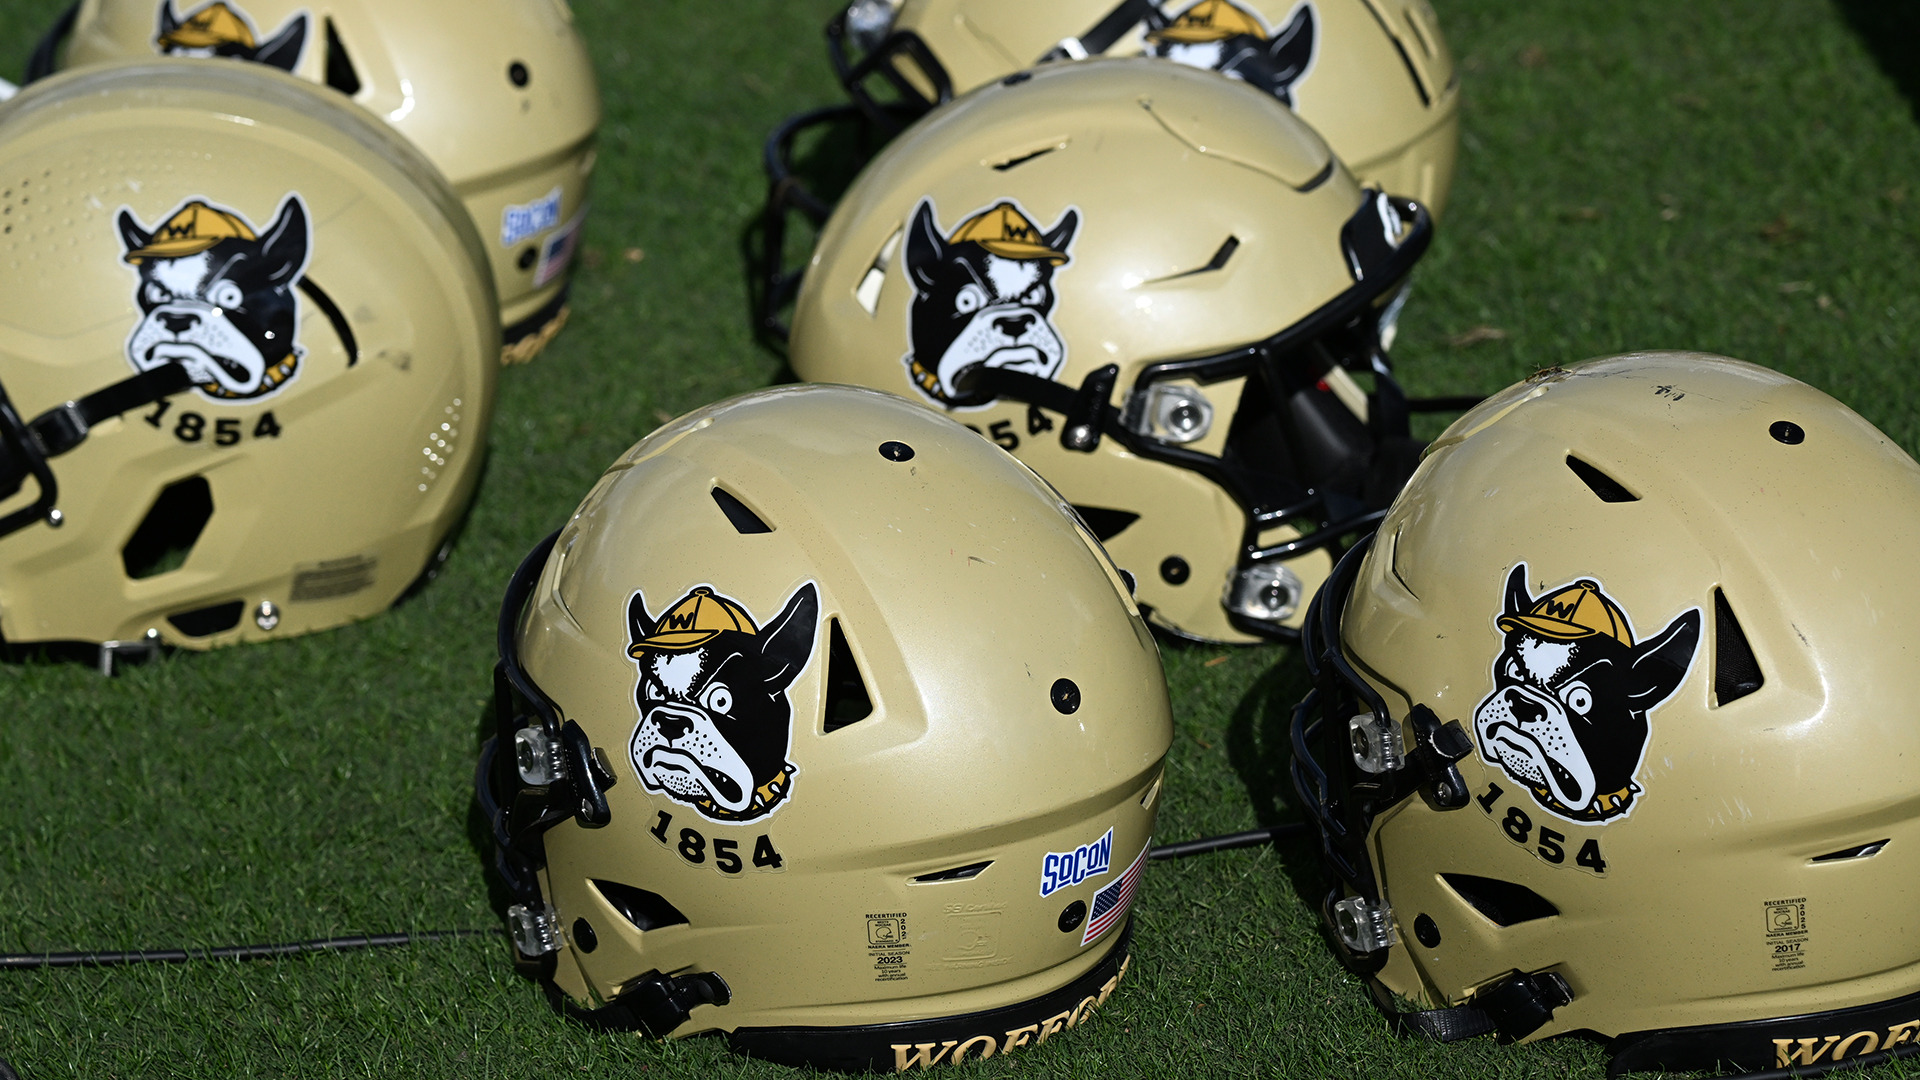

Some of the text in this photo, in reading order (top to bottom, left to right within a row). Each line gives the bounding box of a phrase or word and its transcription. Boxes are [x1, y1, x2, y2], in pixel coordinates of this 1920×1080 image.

[167, 222, 194, 237] W
[1004, 223, 1029, 238] W
[144, 398, 282, 446] 1854
[1546, 600, 1575, 619] W
[669, 612, 695, 630] W
[1476, 782, 1607, 873] 1854
[650, 810, 783, 874] 1854
[1764, 897, 1807, 906] RECERTIFIED
[1774, 943, 1801, 953] 2017
[877, 956, 903, 964] 2023
[1772, 1019, 1920, 1069] WOF
